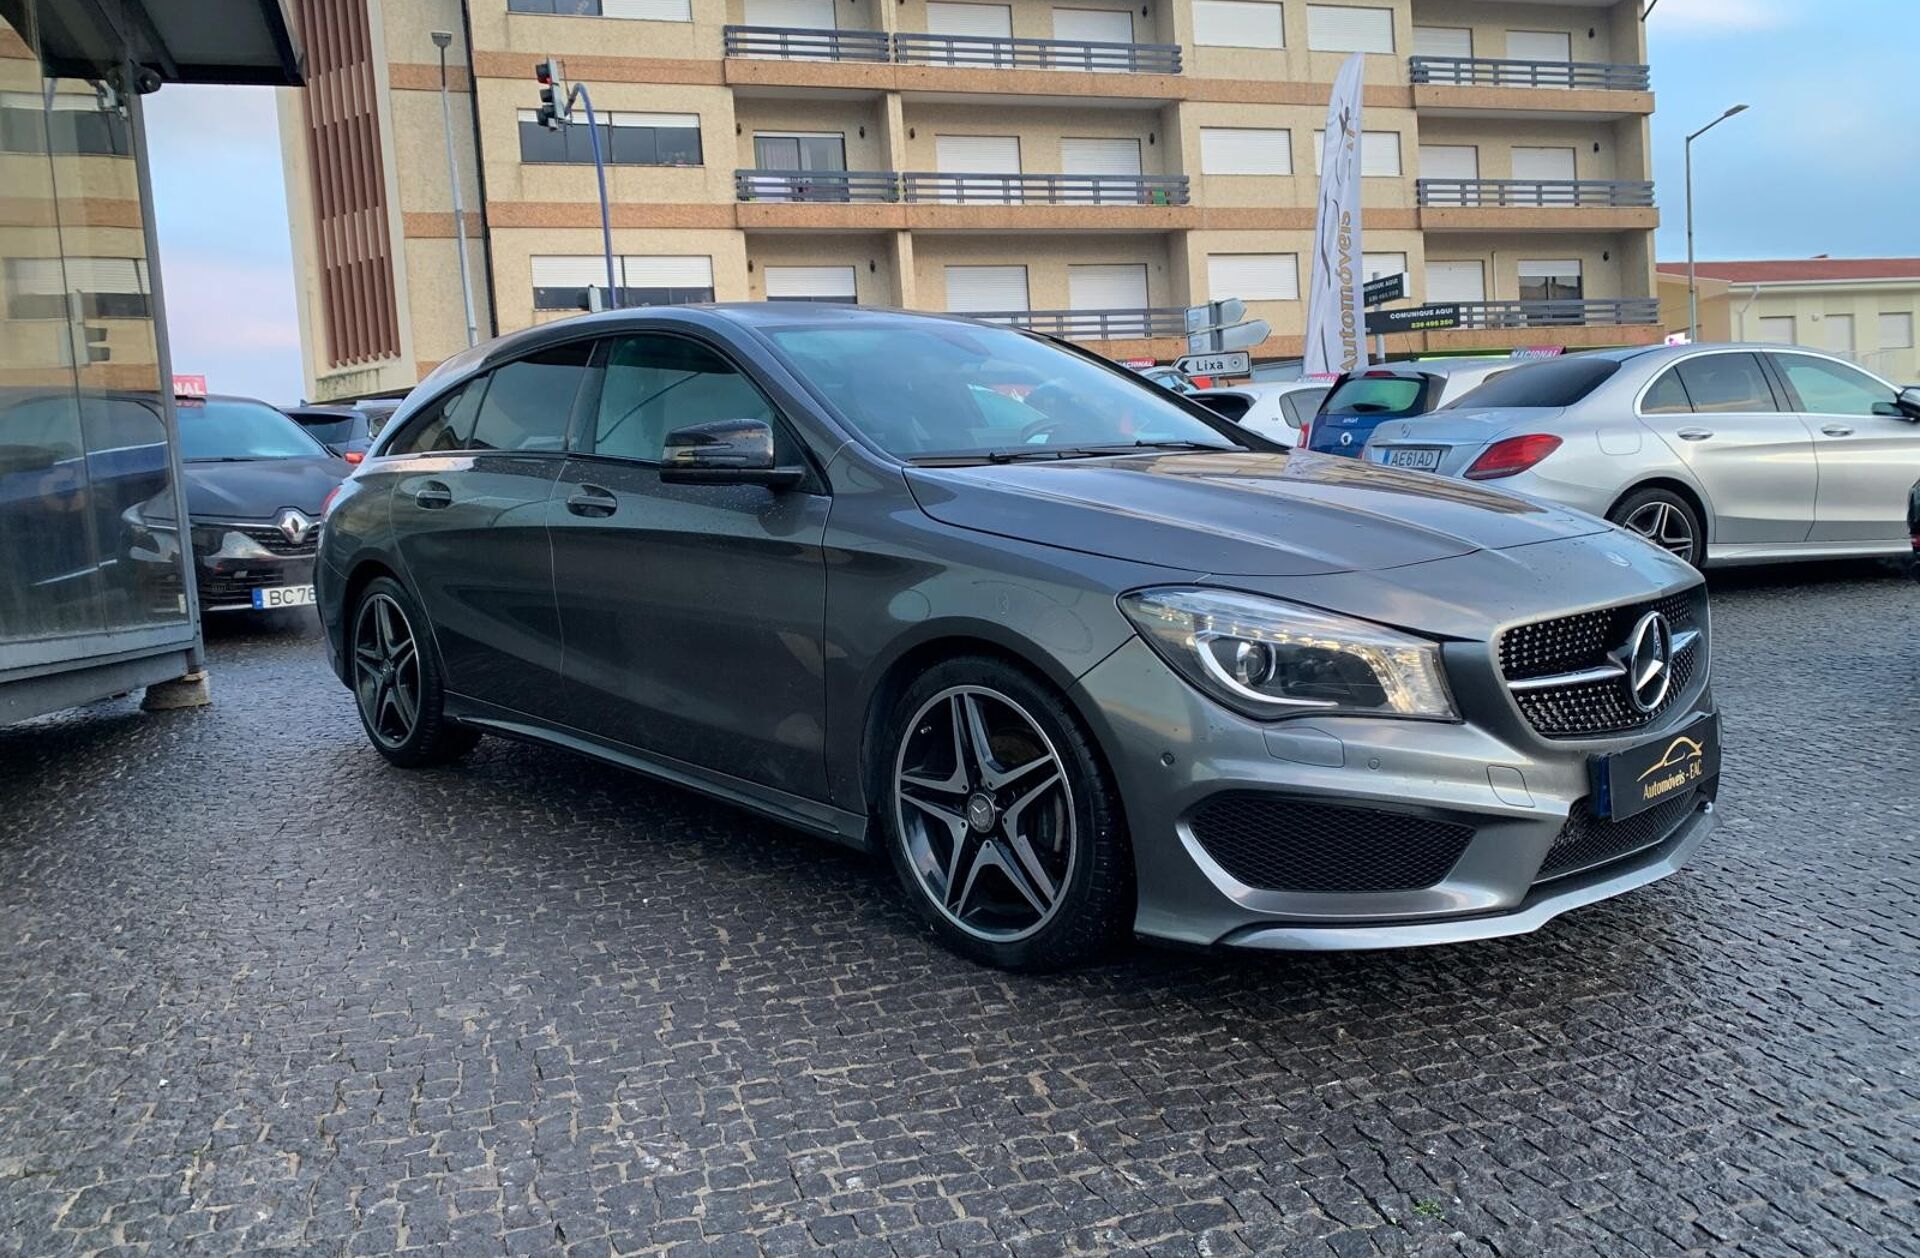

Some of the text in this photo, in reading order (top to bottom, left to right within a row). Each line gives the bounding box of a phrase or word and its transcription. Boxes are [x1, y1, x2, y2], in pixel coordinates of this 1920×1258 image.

[1335, 210, 1357, 372] Automóveis
[1390, 307, 1453, 319] COMUNIQUE AQUI
[1196, 360, 1224, 372] Lixa
